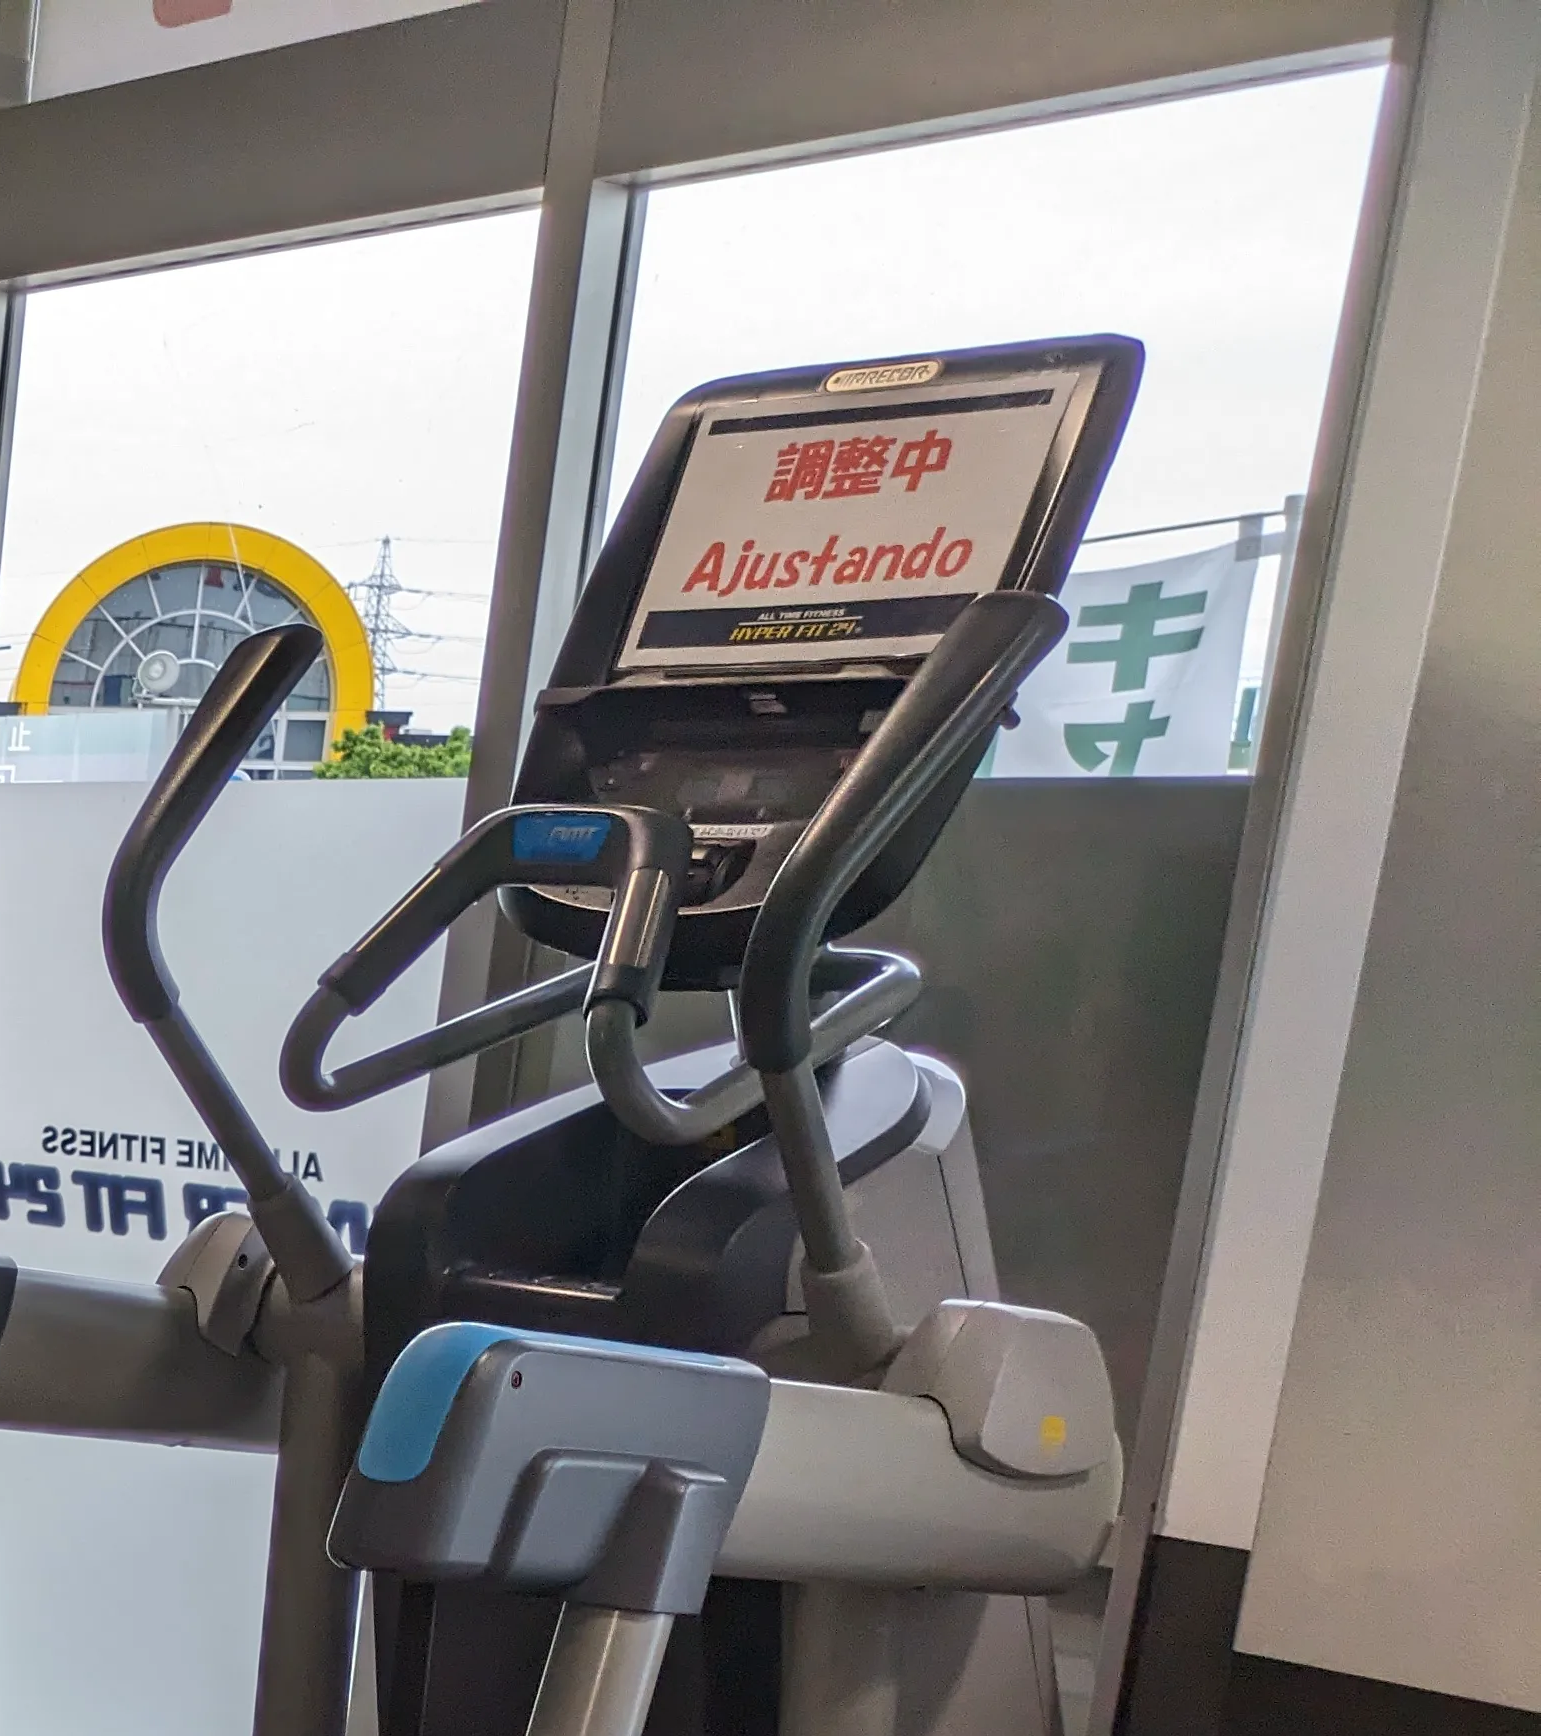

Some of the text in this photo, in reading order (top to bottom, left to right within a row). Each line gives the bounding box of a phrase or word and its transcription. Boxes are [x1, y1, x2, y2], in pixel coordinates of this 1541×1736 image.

[764, 429, 953, 502] 調整中
[681, 526, 973, 596] Ajustando
[729, 620, 857, 642] HYPER FIT 24
[757, 608, 845, 622] ALL TIME FITNESS
